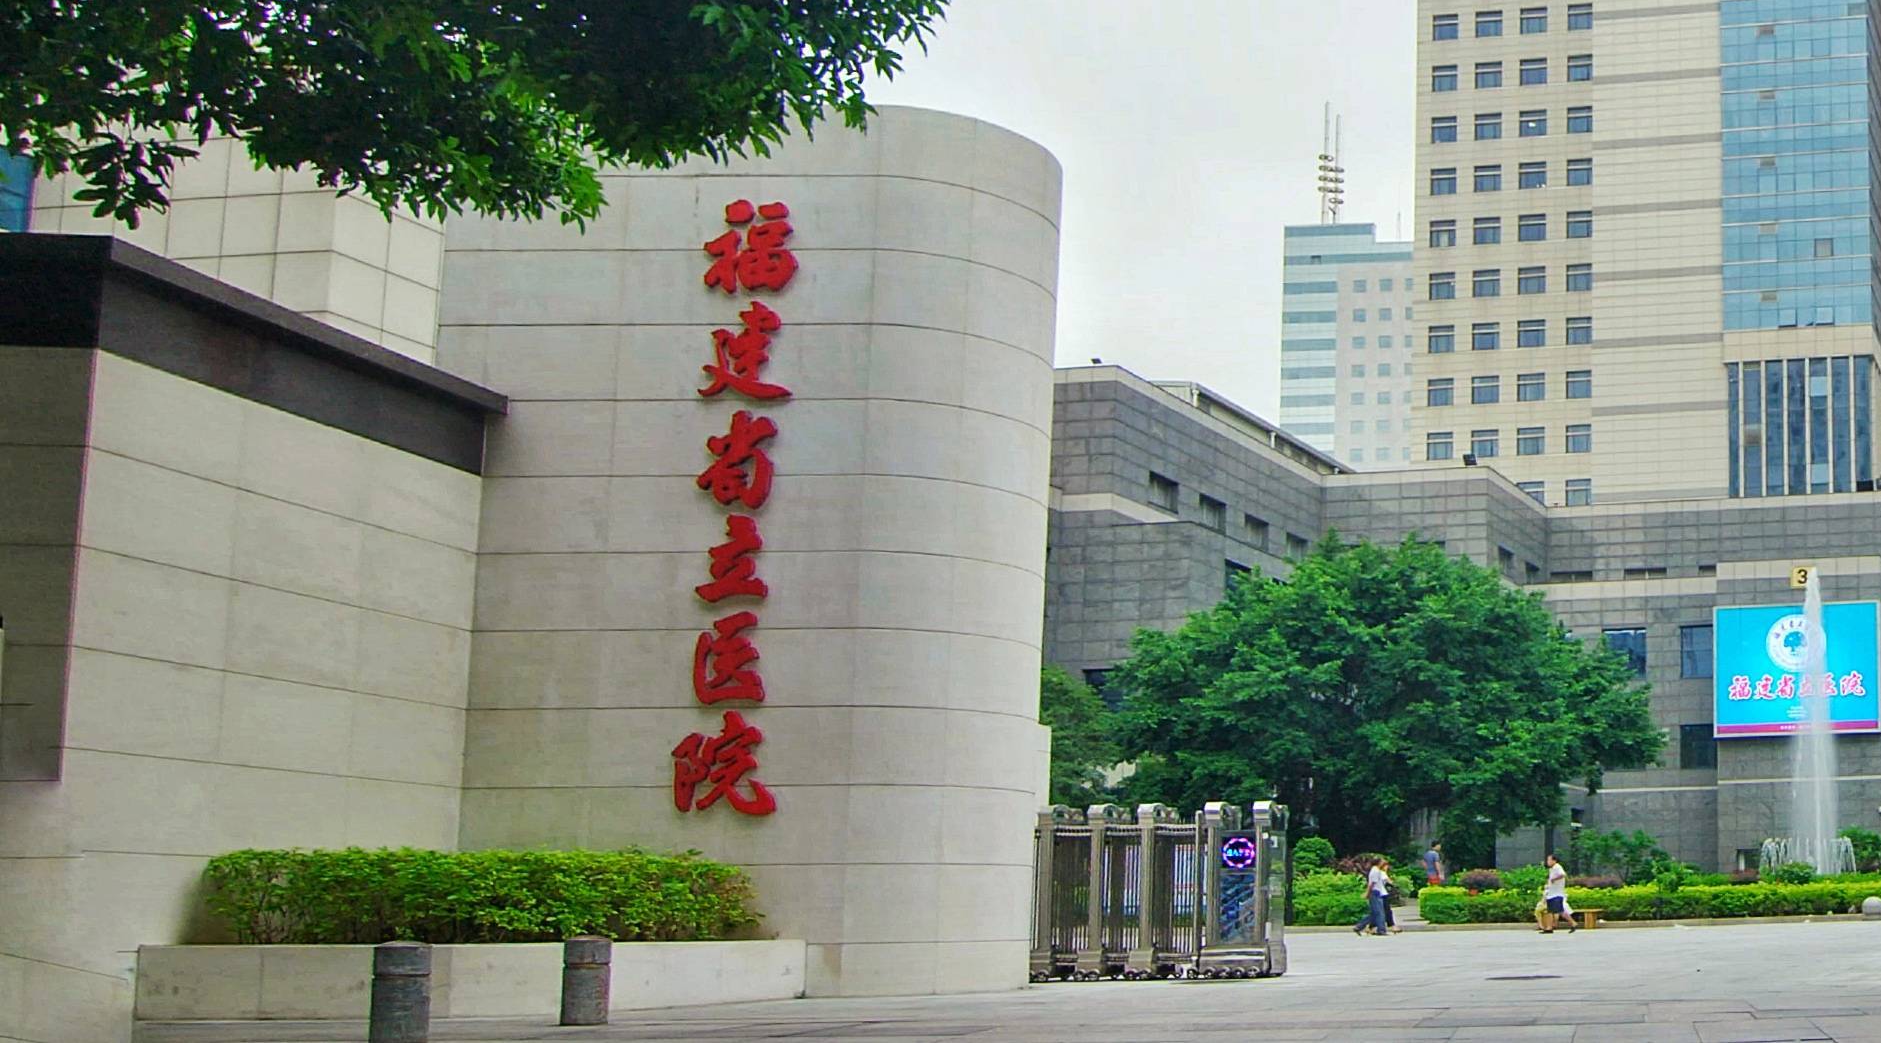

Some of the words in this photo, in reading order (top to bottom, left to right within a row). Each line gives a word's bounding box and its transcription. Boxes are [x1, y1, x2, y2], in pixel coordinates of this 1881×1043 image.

[672, 198, 799, 817] 福建省立医院
[1797, 569, 1808, 584] 3
